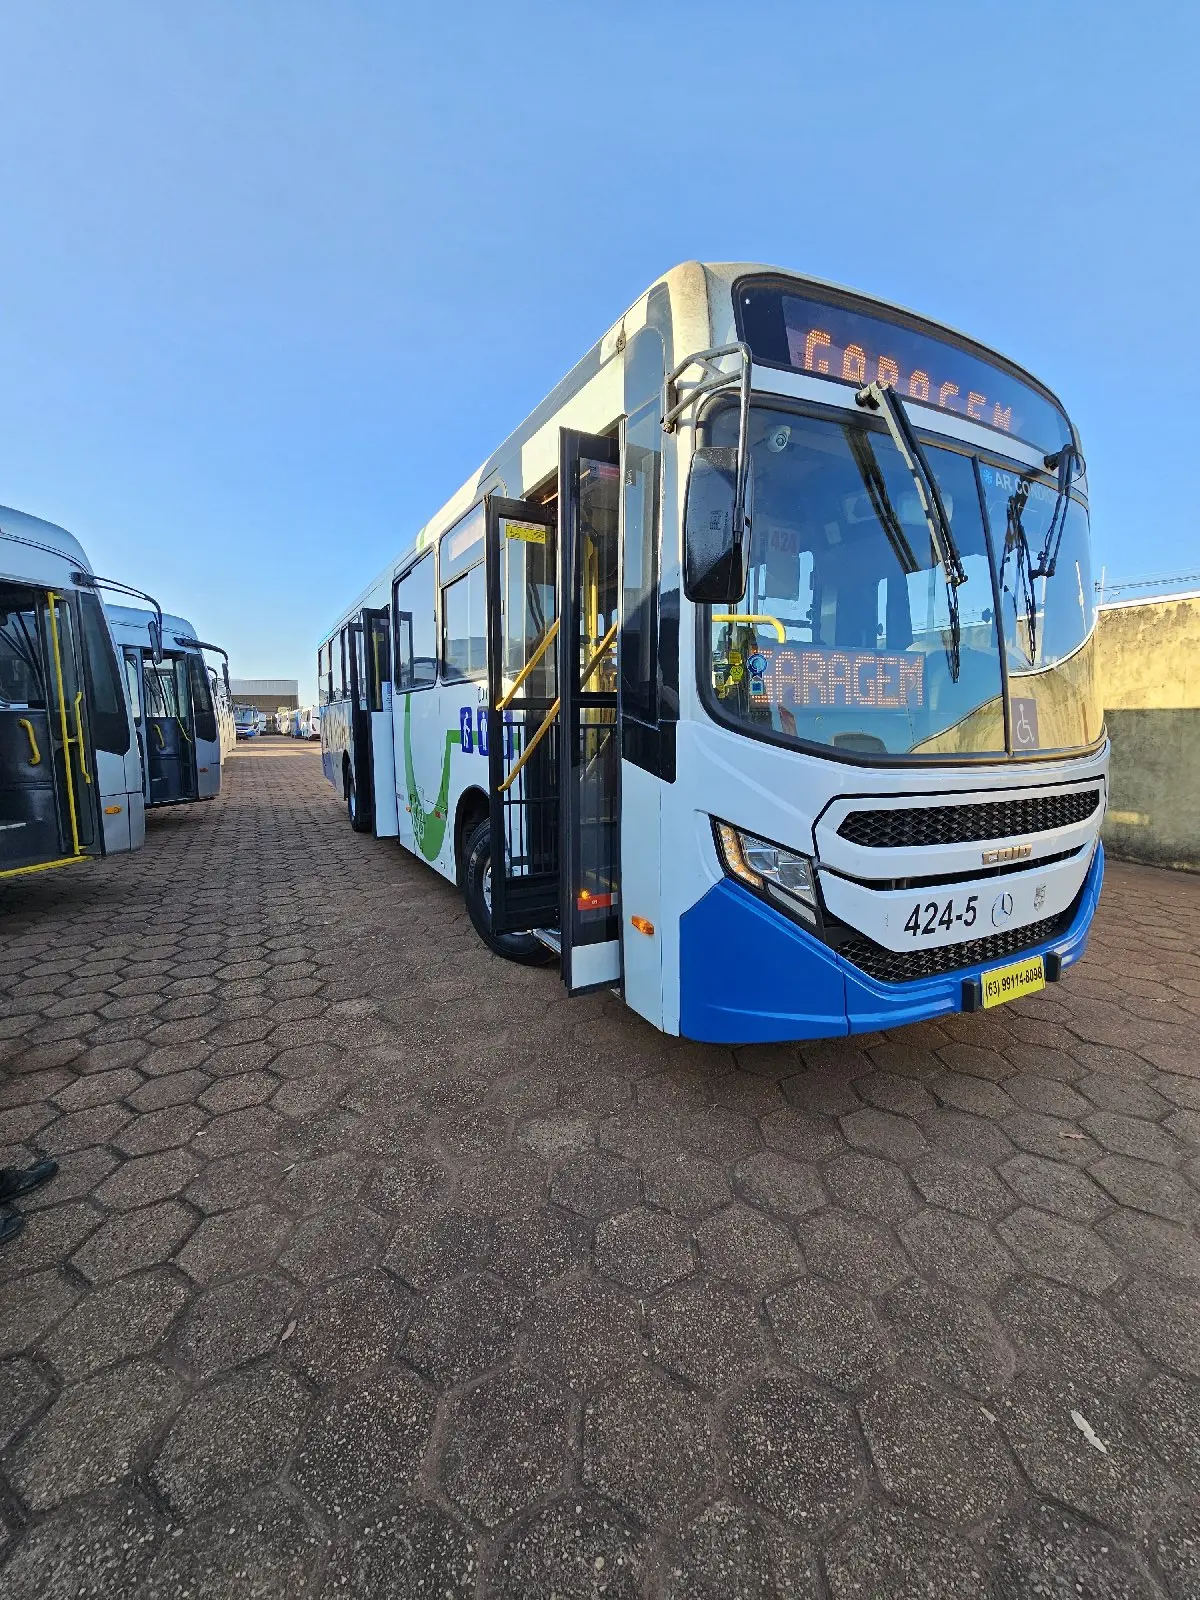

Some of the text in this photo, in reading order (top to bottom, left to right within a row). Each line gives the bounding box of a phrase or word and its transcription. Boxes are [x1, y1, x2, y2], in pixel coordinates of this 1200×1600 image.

[804, 329, 1012, 432] GARAGEM
[995, 472, 1012, 493] AR
[904, 895, 979, 936] 424-5
[985, 966, 1043, 998] (63) 99114-8098
